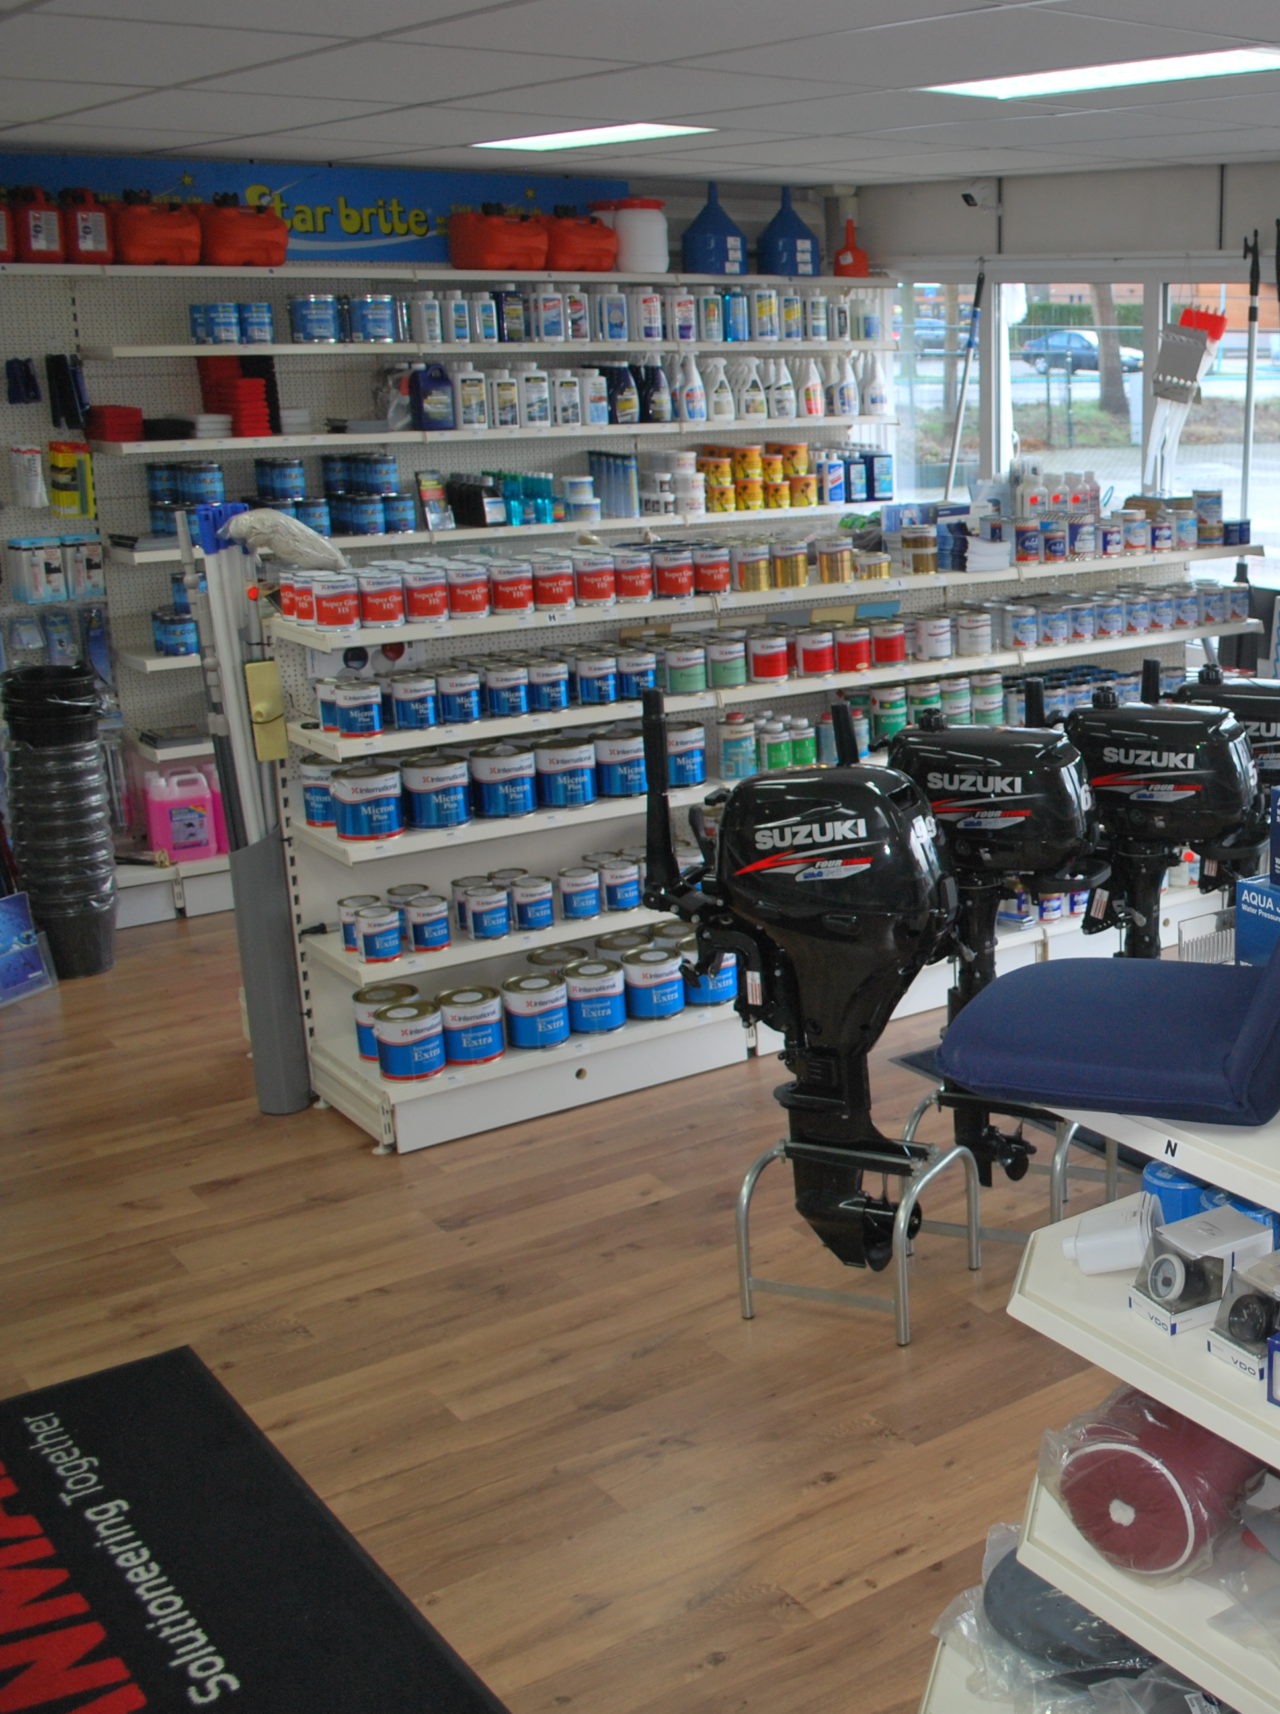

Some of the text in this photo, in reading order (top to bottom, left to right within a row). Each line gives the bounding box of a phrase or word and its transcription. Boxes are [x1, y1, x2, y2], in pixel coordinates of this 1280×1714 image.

[338, 195, 428, 236] brite
[556, 755, 592, 764] International
[1103, 747, 1195, 770] SUZUKI
[497, 763, 533, 773] International
[431, 773, 466, 783] International
[556, 775, 588, 785] Micron
[927, 772, 1022, 794] SUZUKI
[359, 783, 398, 793] International
[498, 783, 530, 794] Micron
[432, 793, 464, 803] Micron
[361, 804, 394, 815] Micron
[443, 801, 458, 809] Plus
[754, 818, 867, 850] SUZUKI
[1241, 889, 1275, 911] AQUA
[1241, 903, 1257, 915] Water
[578, 983, 616, 993] International
[653, 992, 679, 1004] Extra
[457, 1010, 496, 1022] International
[582, 1007, 612, 1018] Extra
[537, 1019, 565, 1032] Extra
[462, 1036, 494, 1048] Extra
[414, 1047, 441, 1062] Extra
[1165, 1140, 1178, 1158] N
[1148, 1312, 1169, 1331] VDO
[1231, 1356, 1256, 1376] VDO
[23, 1411, 106, 1507] Together
[83, 1498, 241, 1706] Solutioneering
